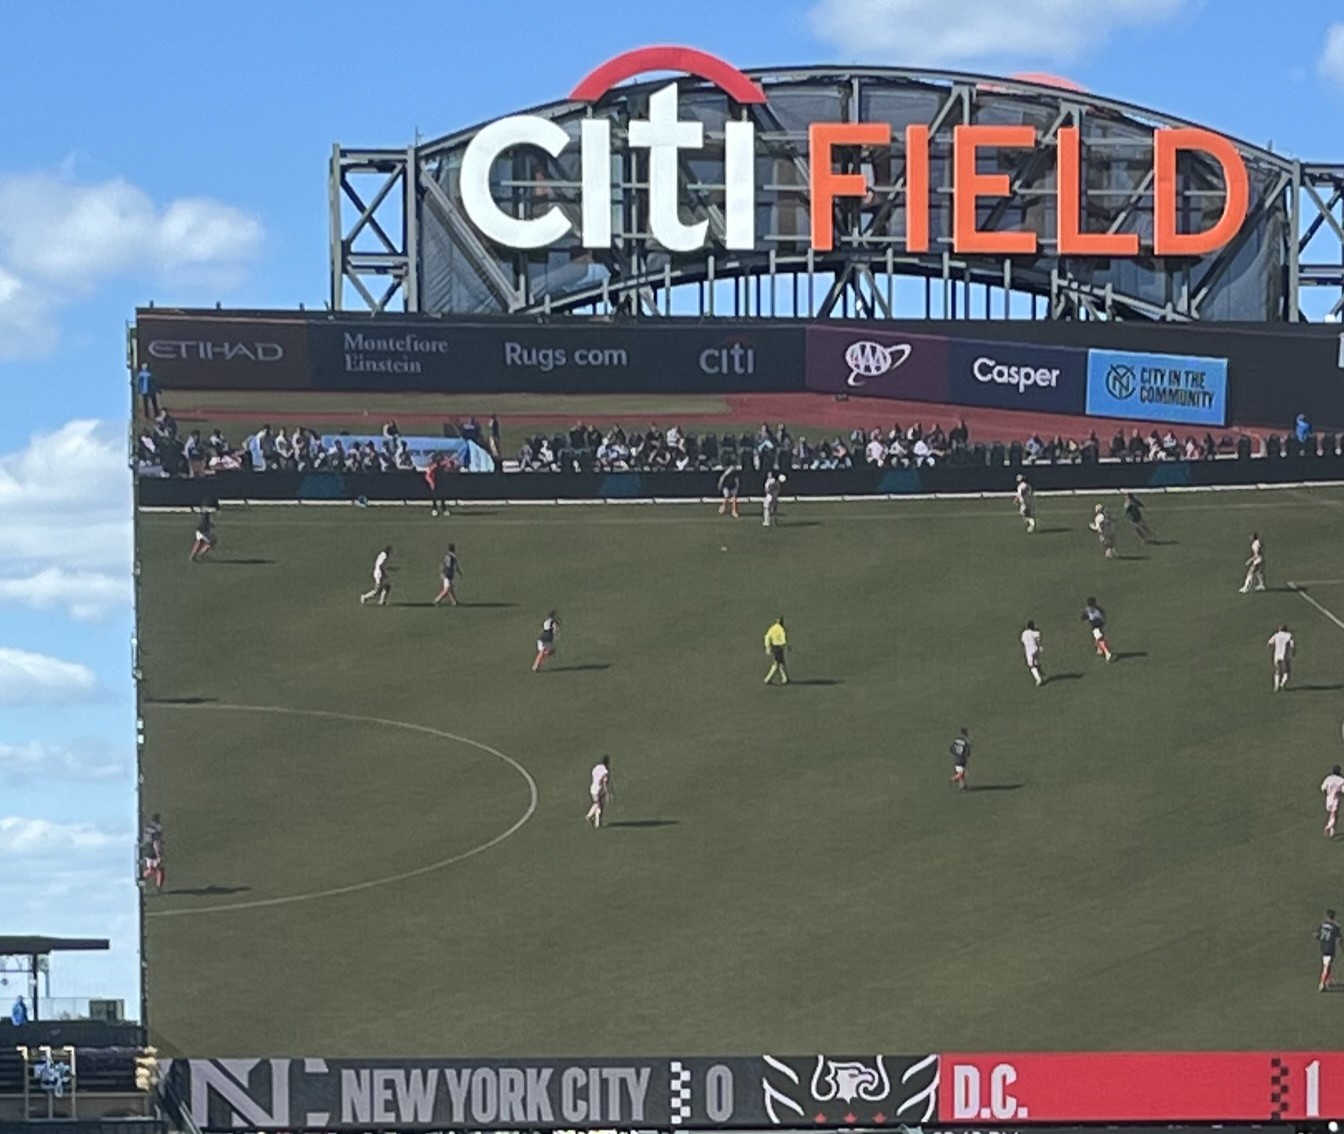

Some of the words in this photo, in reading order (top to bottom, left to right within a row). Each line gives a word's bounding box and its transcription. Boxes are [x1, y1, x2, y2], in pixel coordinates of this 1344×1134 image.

[459, 82, 755, 253] citi
[810, 124, 1249, 257] FIELD
[148, 340, 284, 362] ETIHAD
[343, 332, 449, 355] Montefiore
[344, 353, 423, 375] Einstein
[973, 357, 1060, 392] Casper
[1140, 367, 1166, 386] CITY
[1168, 369, 1181, 387] IN
[1184, 371, 1206, 390] THE
[1140, 386, 1215, 409] COMMUNITY
[341, 1068, 446, 1124] NEW
[446, 1067, 555, 1124] YORK
[563, 1066, 652, 1123] CITY
[706, 1065, 735, 1124] 0
[954, 1063, 1029, 1120] D.C.
[1304, 1060, 1323, 1118] 1
